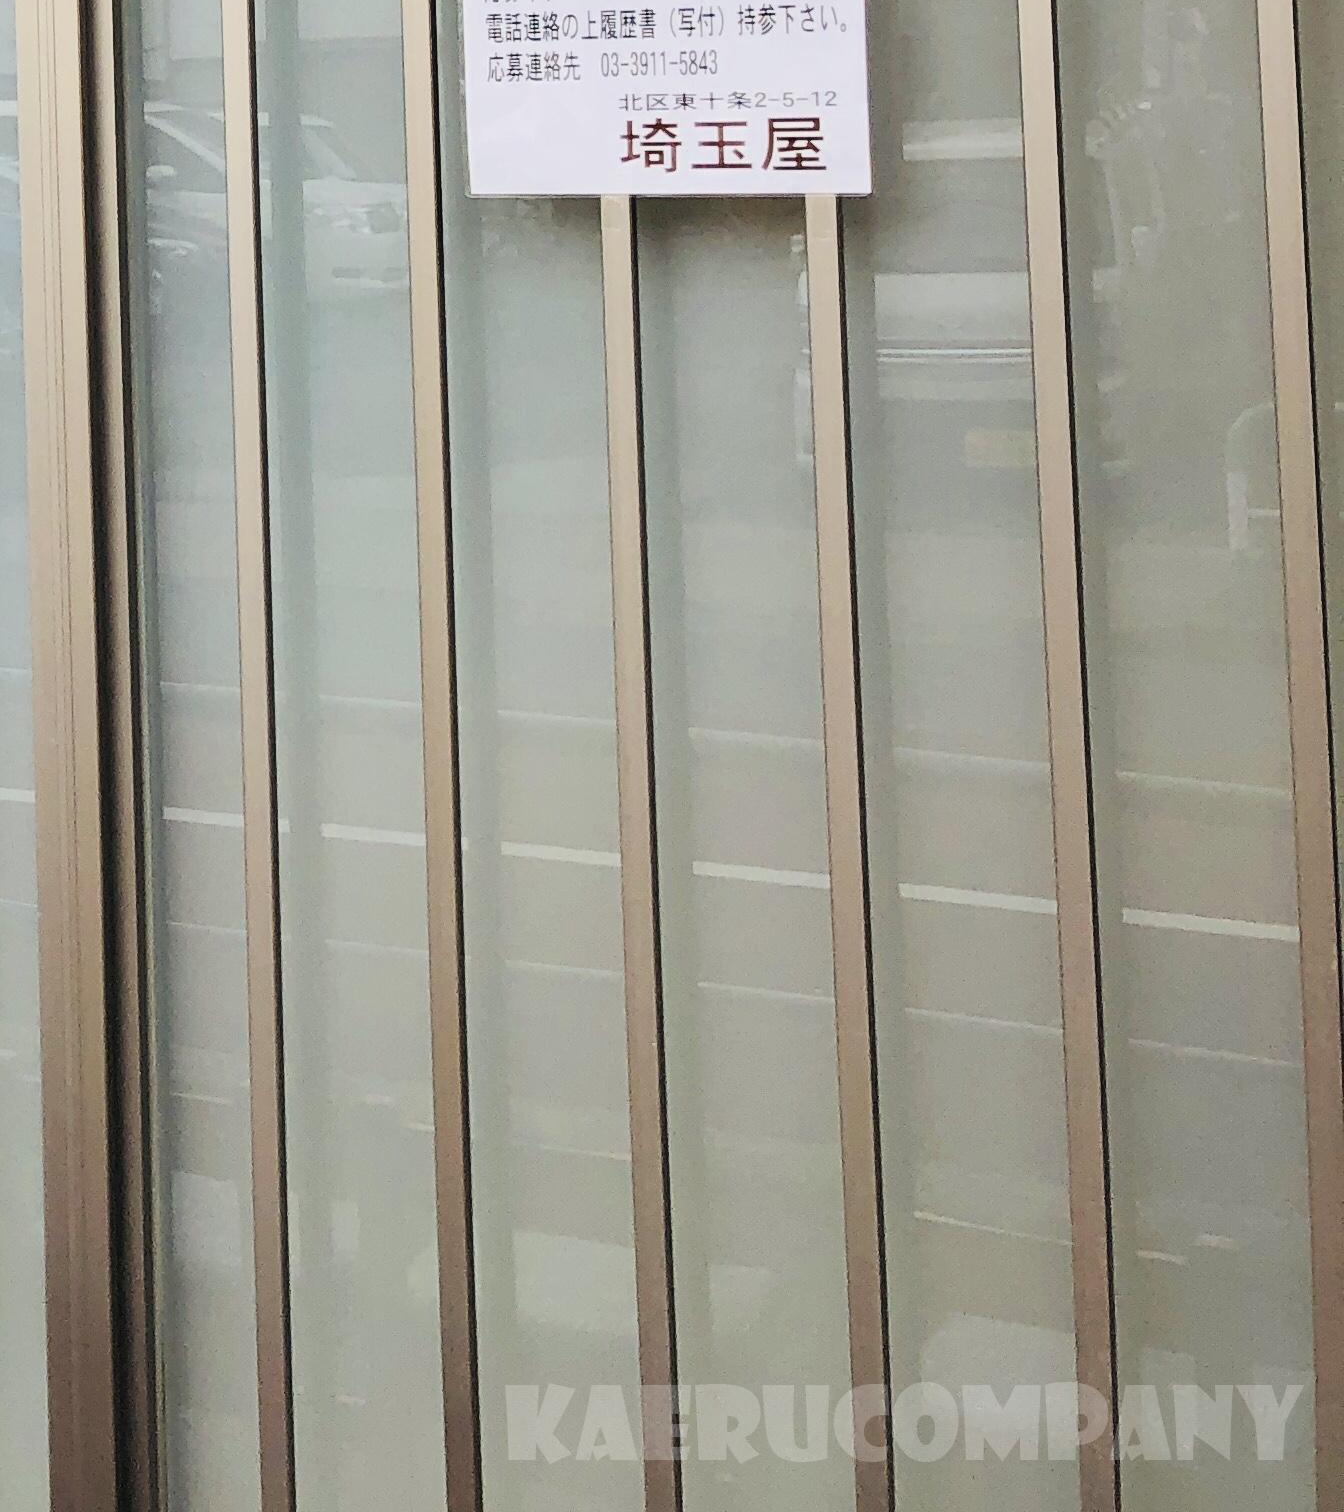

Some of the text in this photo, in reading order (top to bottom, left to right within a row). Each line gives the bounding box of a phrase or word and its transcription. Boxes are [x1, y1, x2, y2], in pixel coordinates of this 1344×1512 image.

[486, 49, 719, 82] 応募連絡先 03-3911-5843
[618, 90, 838, 113] 北区東十条2-5-12
[619, 117, 827, 173] 埼玉屋
